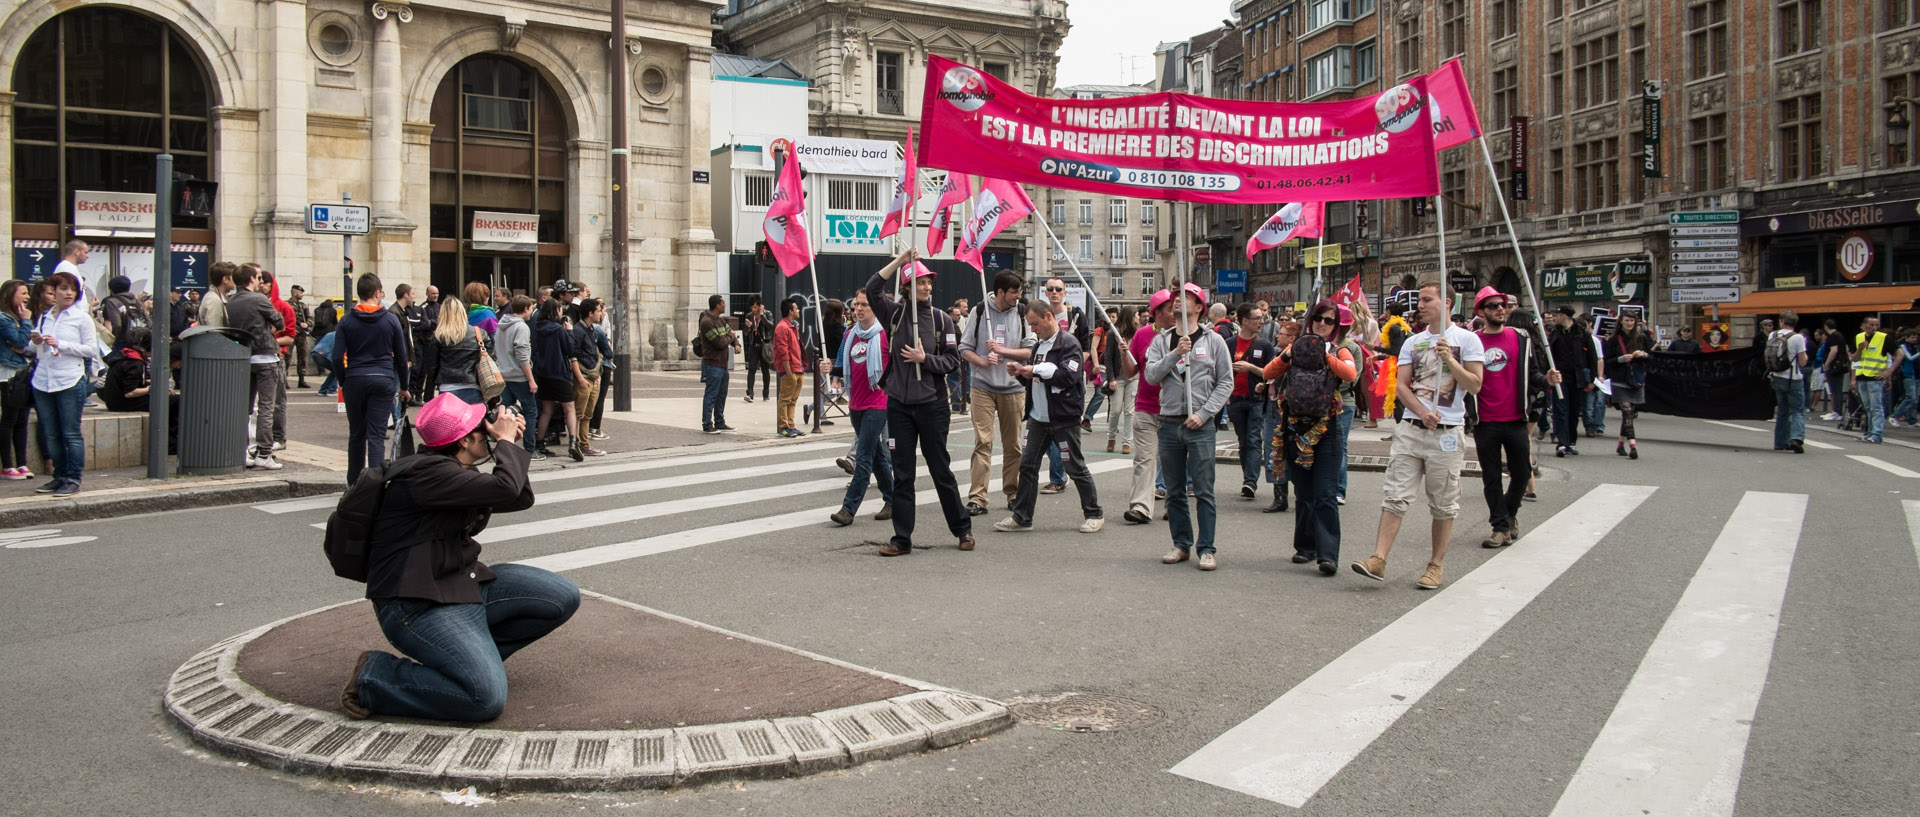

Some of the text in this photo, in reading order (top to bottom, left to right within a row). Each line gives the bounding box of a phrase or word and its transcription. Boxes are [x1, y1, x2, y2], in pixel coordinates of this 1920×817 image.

[945, 69, 979, 90] SOS
[936, 88, 995, 103] homophobie
[1051, 102, 1322, 139] L'INEGALITÉ DEVANT LA LOI
[1375, 95, 1428, 134] homophobie
[981, 115, 1389, 167] EST LA PREMIERE DES DISCRIMINATIONS
[797, 144, 859, 158] demathieu
[861, 147, 888, 159] bard
[1645, 144, 1655, 170] DLM
[1128, 171, 1137, 182] 0
[1140, 172, 1167, 185] 810
[1170, 174, 1195, 186] 108
[1200, 175, 1226, 188] 135
[1256, 174, 1352, 190] 01.48.06.42.41
[77, 200, 157, 213] BRASSERI
[345, 216, 366, 224] Europe
[475, 218, 537, 232] BRASSERIE
[844, 214, 884, 222] LOCATIONS
[1704, 213, 1737, 221] DIRECTIONS
[1844, 242, 1866, 270] QG
[1624, 264, 1647, 275] DLM
[1544, 271, 1567, 288] DLM
